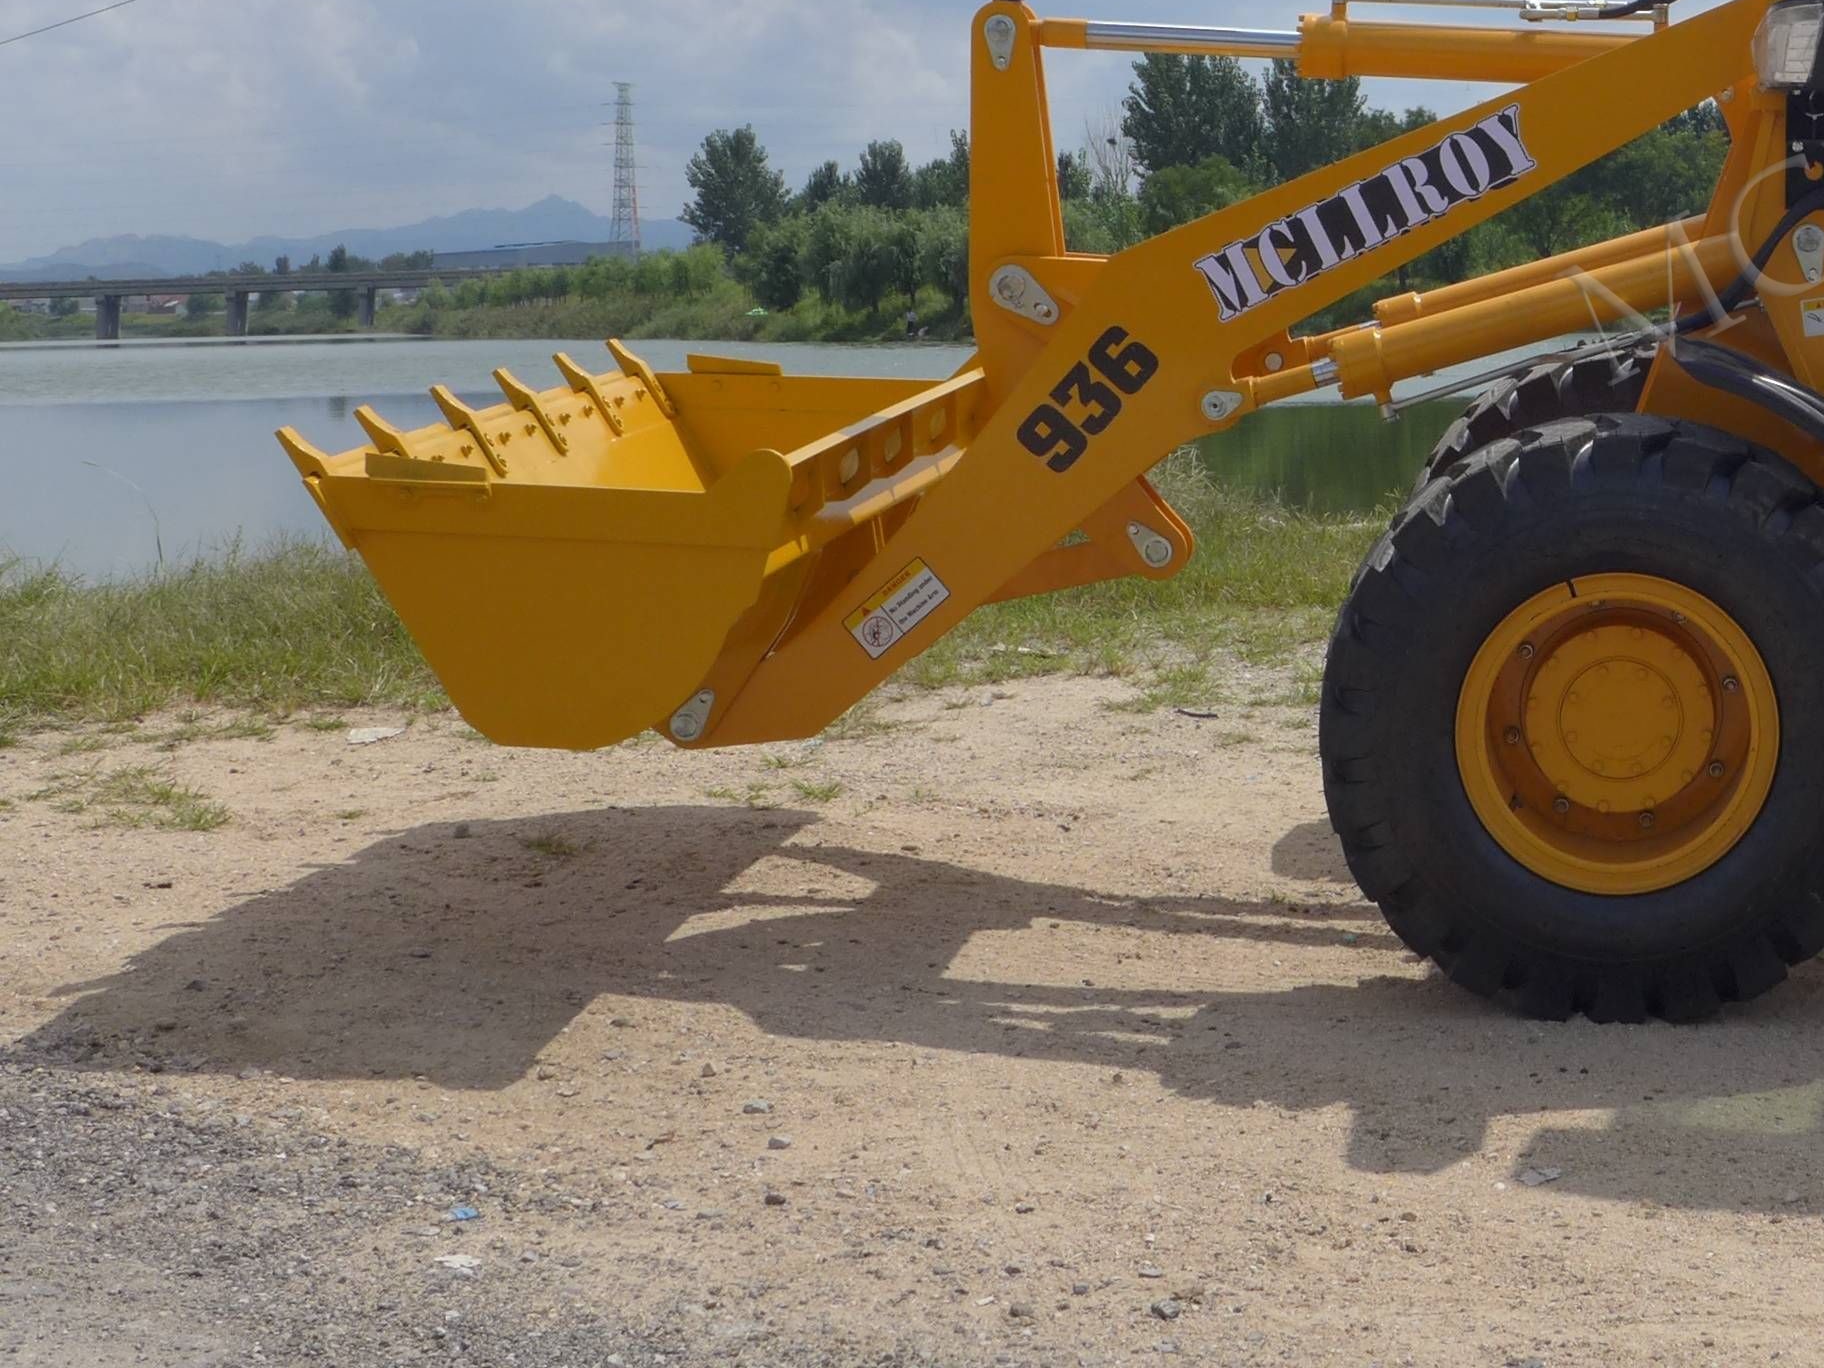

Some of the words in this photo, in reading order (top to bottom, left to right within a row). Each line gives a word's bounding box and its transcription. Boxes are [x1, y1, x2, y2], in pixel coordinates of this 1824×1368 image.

[1194, 103, 1536, 323] MCLLROY
[1017, 325, 1159, 473] 936
[882, 570, 911, 597] DANGER
